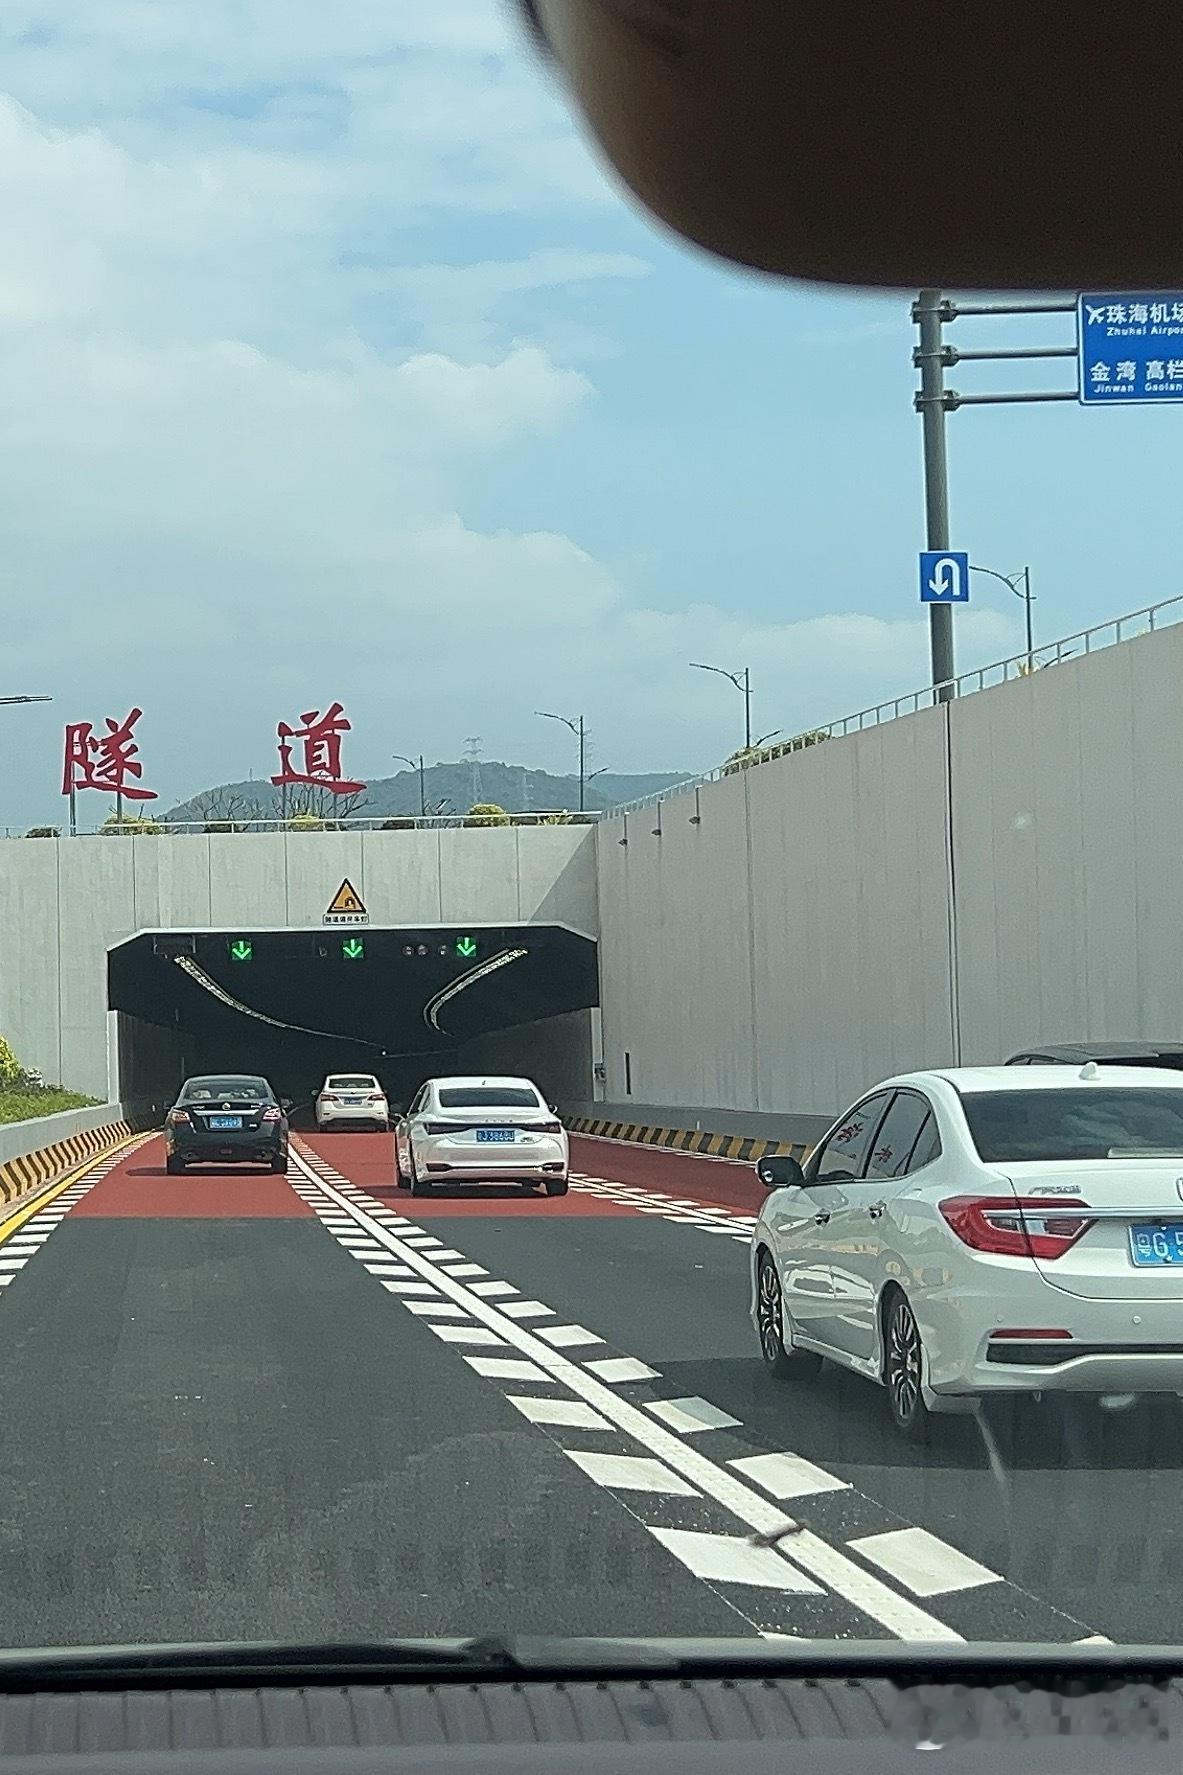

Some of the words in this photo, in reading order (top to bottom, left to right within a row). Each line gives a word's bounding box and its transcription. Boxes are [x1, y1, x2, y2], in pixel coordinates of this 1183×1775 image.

[1106, 303, 1183, 324] 珠海机场
[1106, 327, 1147, 336] Zhuhai
[1094, 383, 1135, 393] Jinwan
